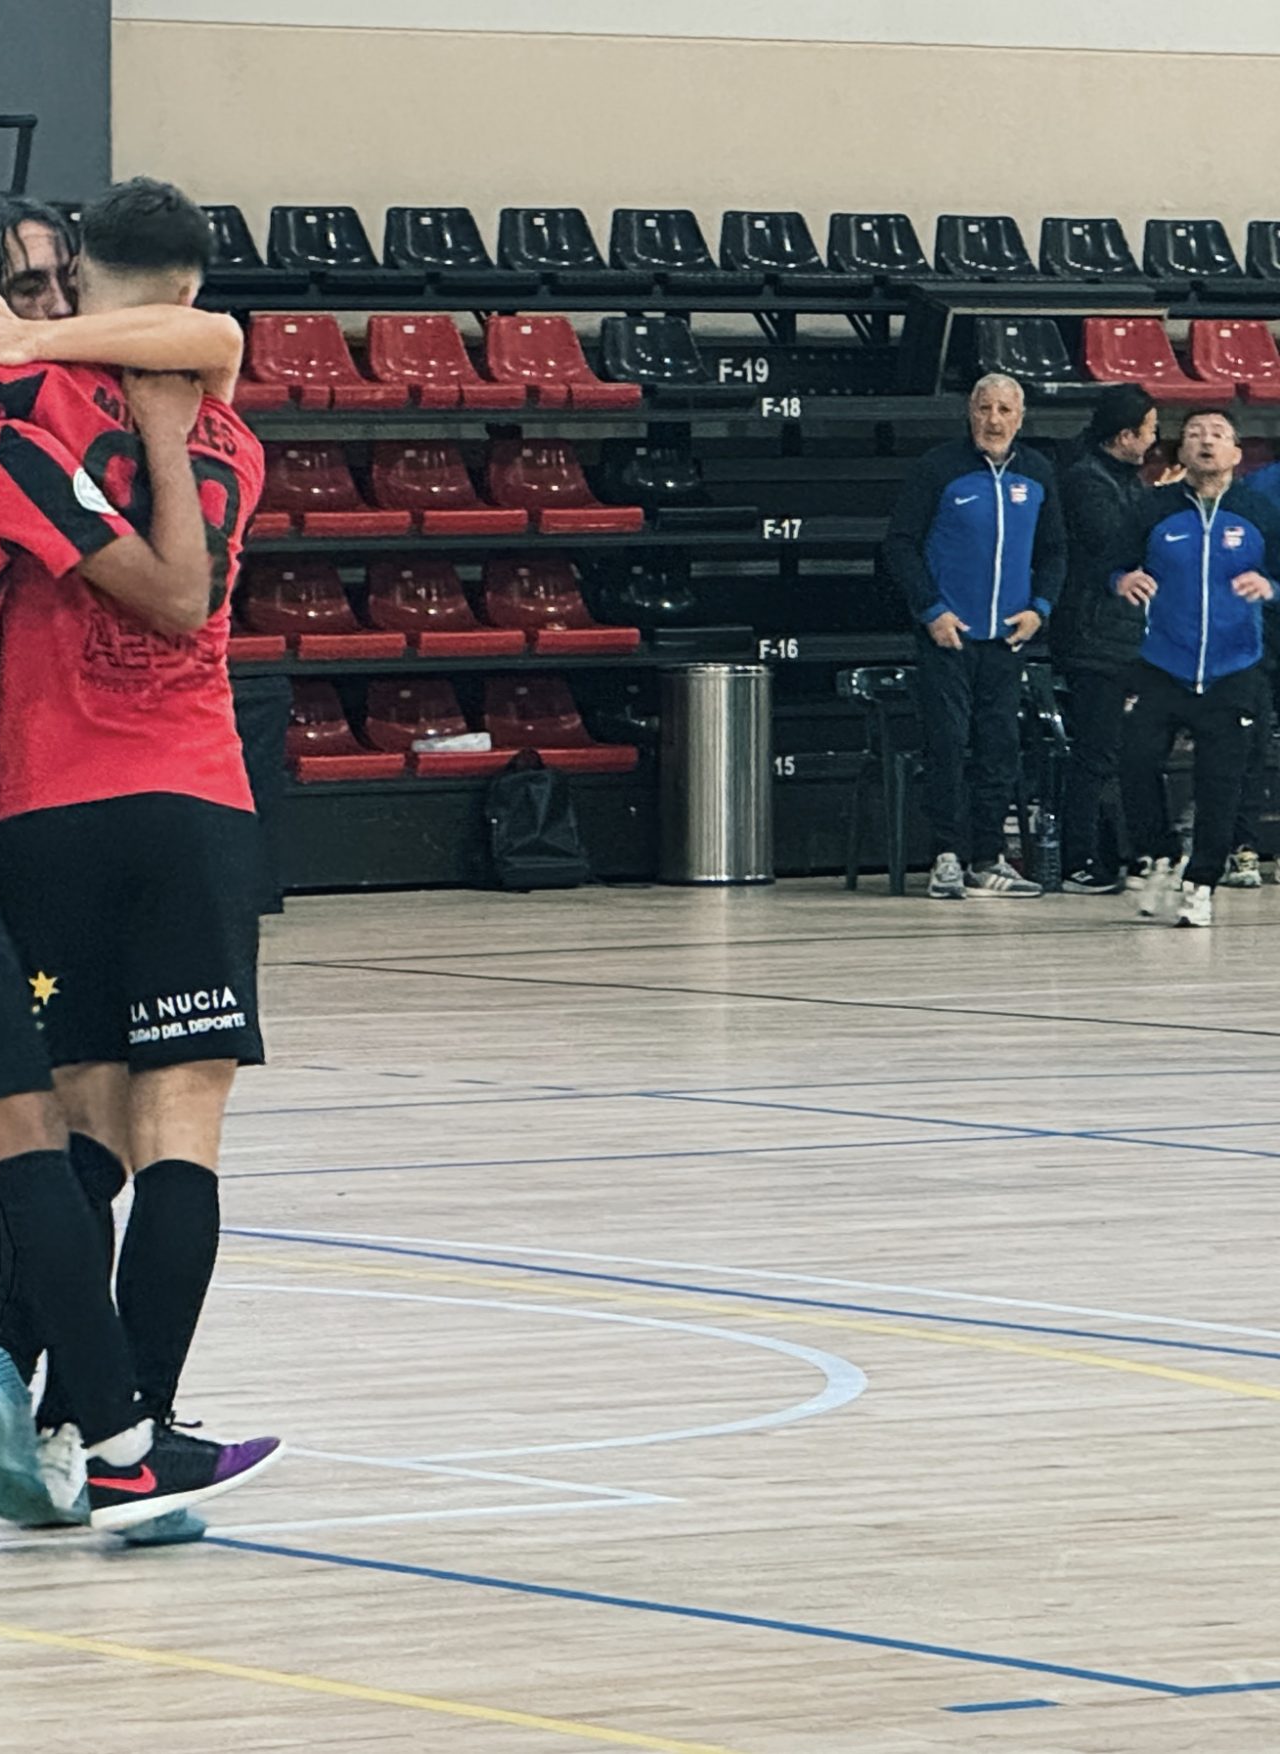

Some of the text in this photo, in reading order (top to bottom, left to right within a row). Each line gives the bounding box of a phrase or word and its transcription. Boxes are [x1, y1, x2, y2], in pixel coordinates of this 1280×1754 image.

[718, 357, 770, 383] F-19
[762, 397, 801, 418] F-18
[763, 518, 803, 540] F-17
[759, 638, 799, 660] F-16
[130, 1002, 150, 1023] LA
[161, 1022, 188, 1040] DEL
[188, 1012, 247, 1035] DEPORTE
